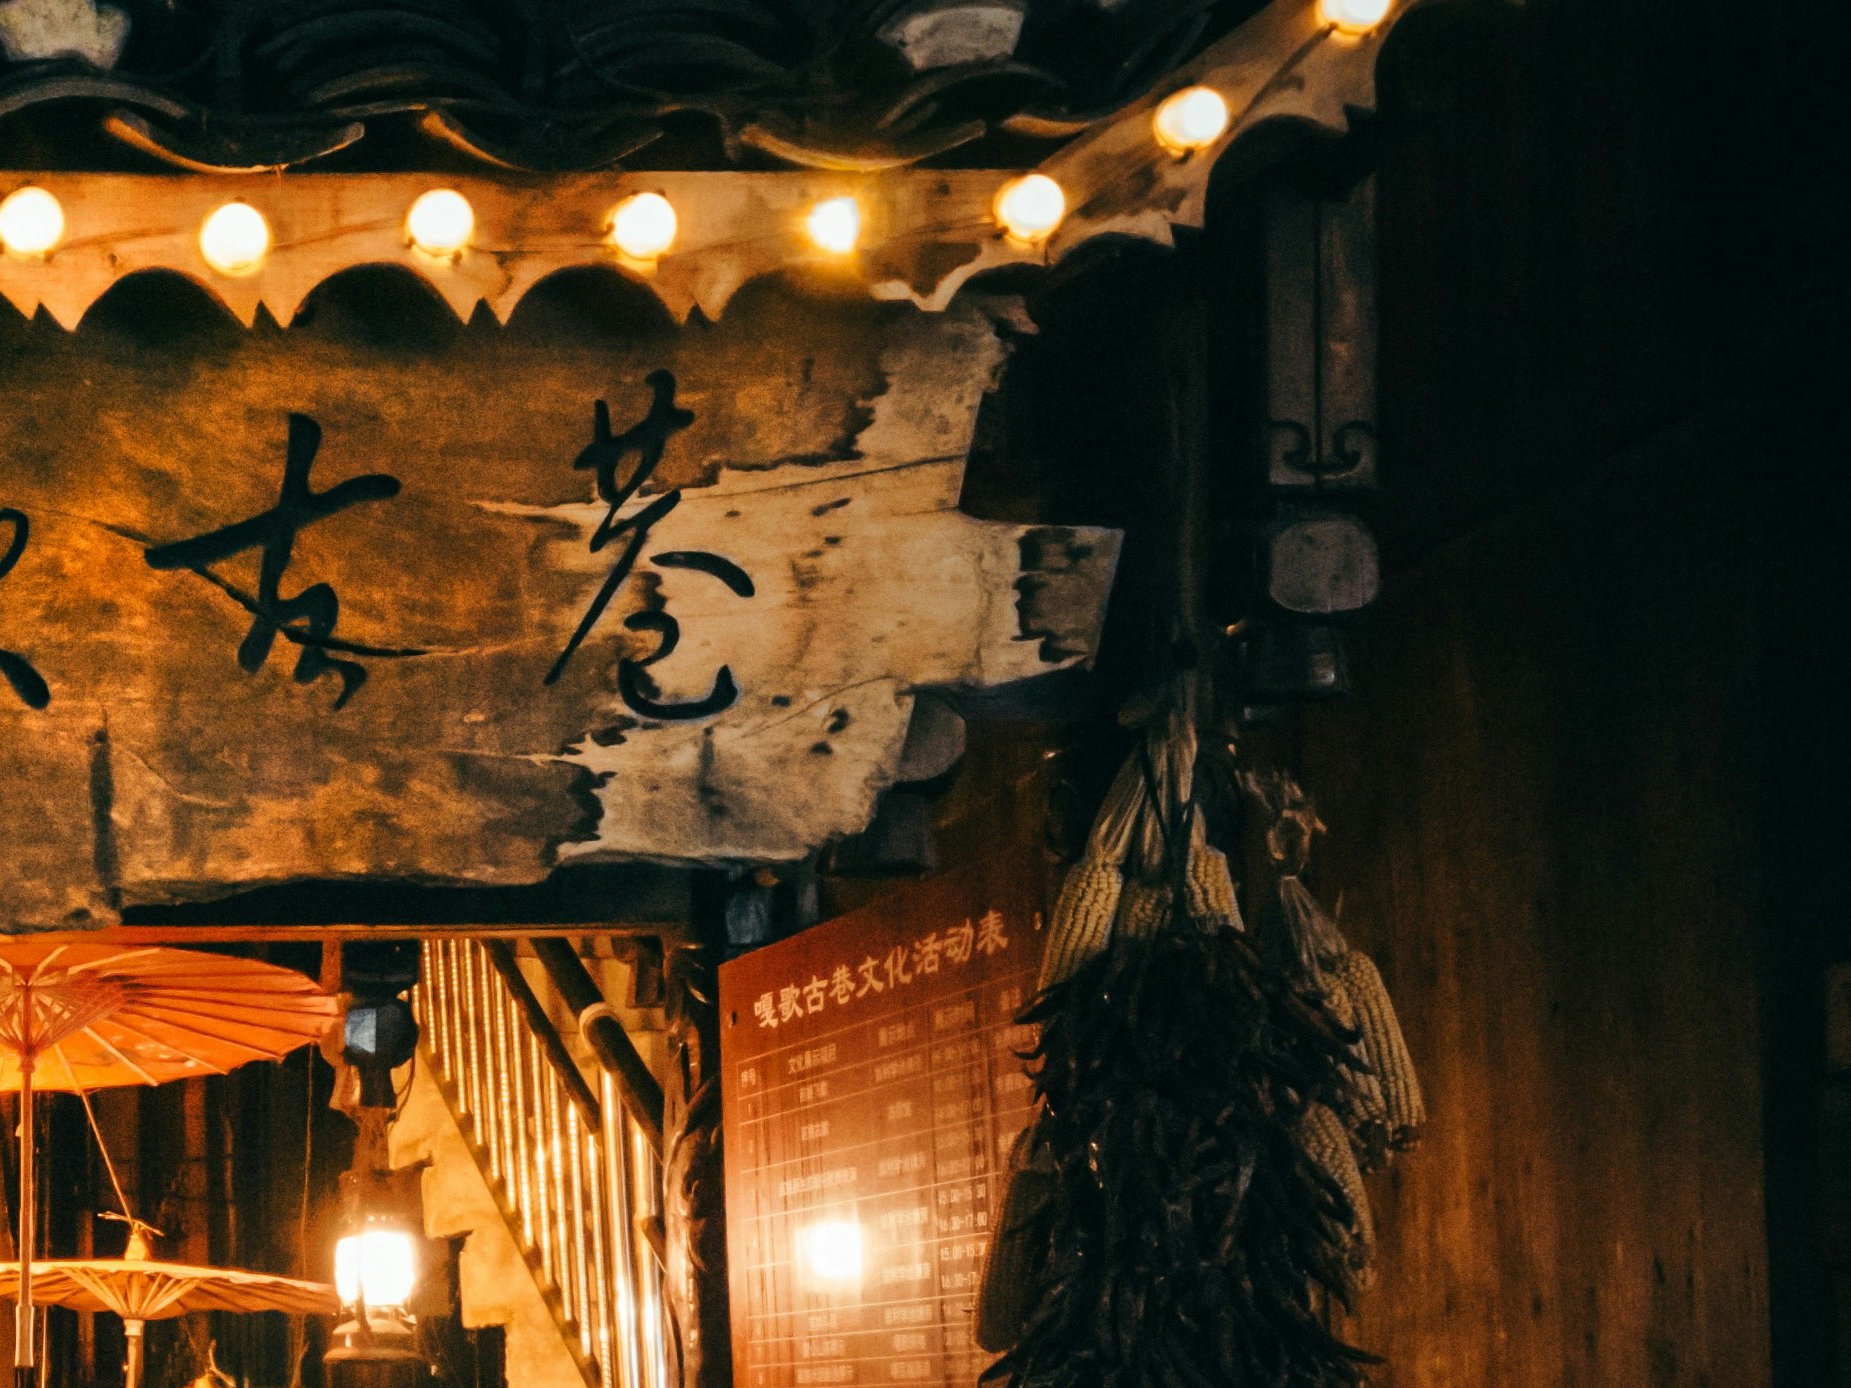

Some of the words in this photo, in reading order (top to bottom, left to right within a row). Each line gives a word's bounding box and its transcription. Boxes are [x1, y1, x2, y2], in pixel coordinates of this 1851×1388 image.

[753, 909, 1009, 1029] 嘎歌古巷文化活动表
